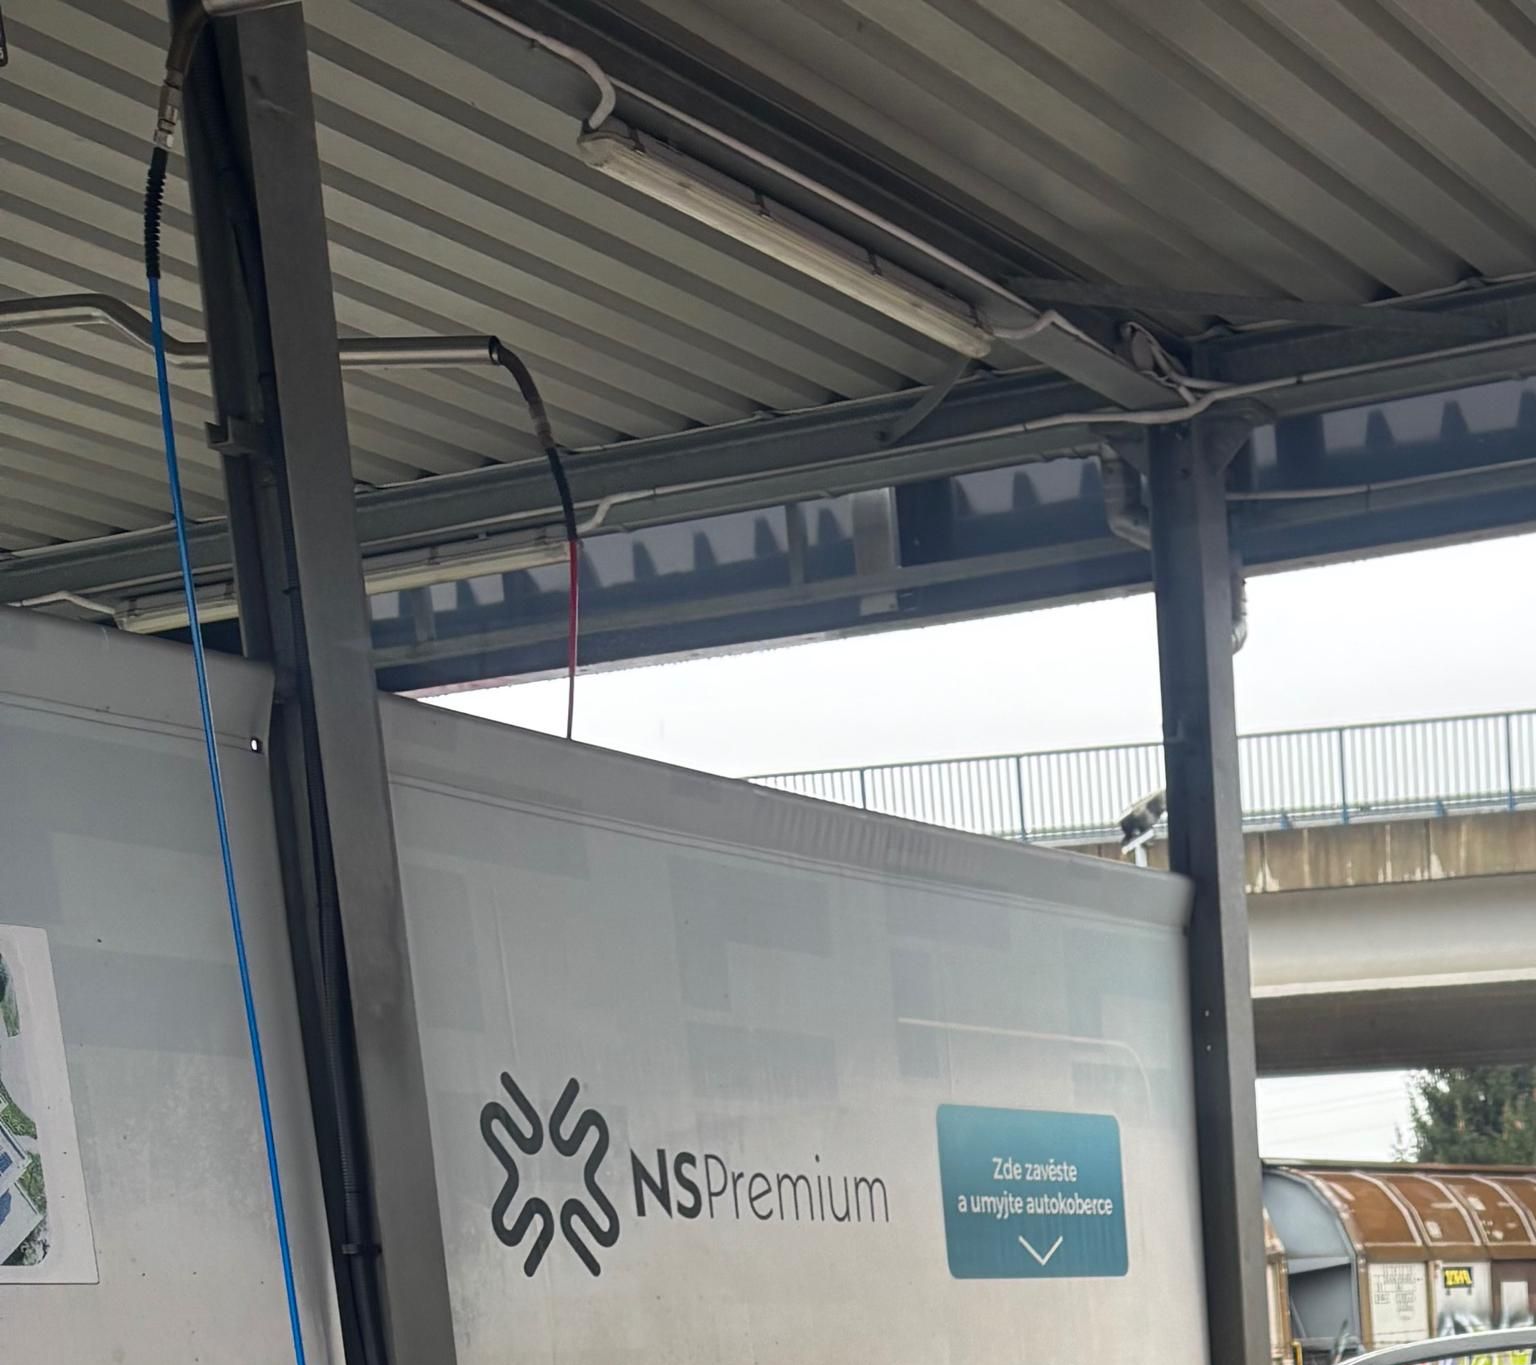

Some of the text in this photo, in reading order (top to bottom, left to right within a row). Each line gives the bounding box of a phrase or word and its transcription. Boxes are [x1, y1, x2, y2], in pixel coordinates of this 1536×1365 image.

[992, 1157, 1022, 1180] Zde
[958, 1190, 1113, 1219] a umyjte autokoberce
